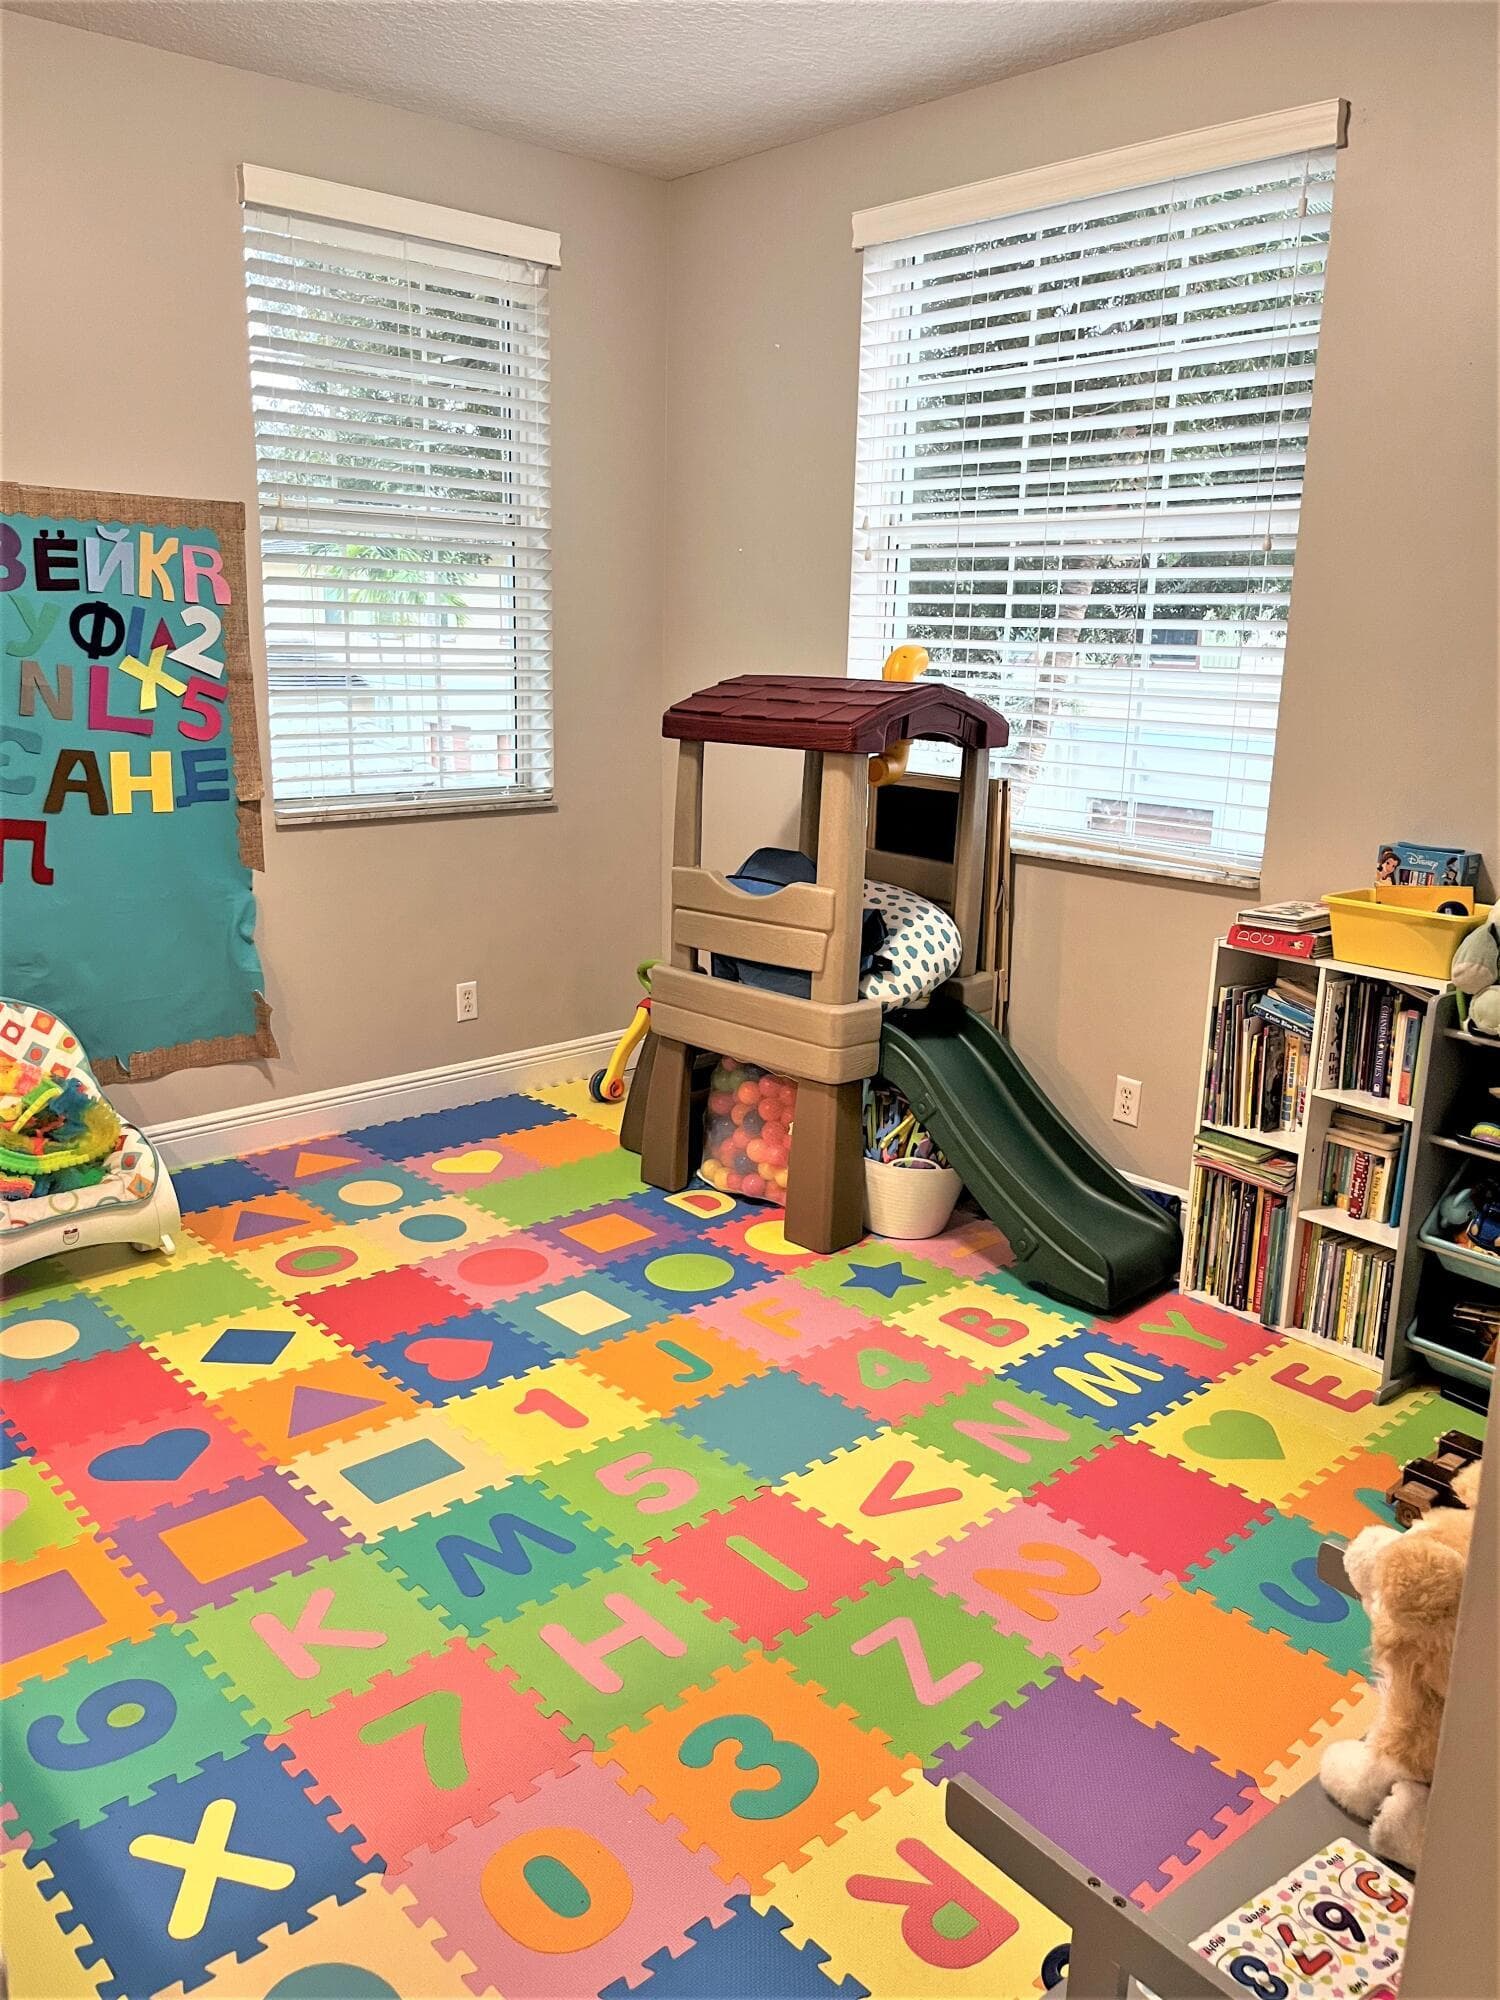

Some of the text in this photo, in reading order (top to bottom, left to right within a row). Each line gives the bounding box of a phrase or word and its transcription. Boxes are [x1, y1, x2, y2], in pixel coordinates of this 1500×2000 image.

[1406, 852, 1439, 870] Disney
[1237, 930, 1275, 946] DOG
[1375, 1050, 1384, 1078] WISHES
[664, 1189, 736, 1219] D
[939, 1306, 1029, 1347] B
[1138, 1310, 1226, 1350] Y
[656, 1339, 713, 1383] J
[1053, 1352, 1164, 1407] M
[595, 1451, 699, 1514] 5
[859, 1460, 963, 1517] V
[436, 1513, 576, 1598] M
[250, 1587, 388, 1679] K
[539, 1593, 688, 1694] H
[358, 1689, 469, 1790] 7
[678, 1714, 819, 1821] 3
[129, 1798, 296, 1940] X
[845, 1838, 1019, 1969] R
